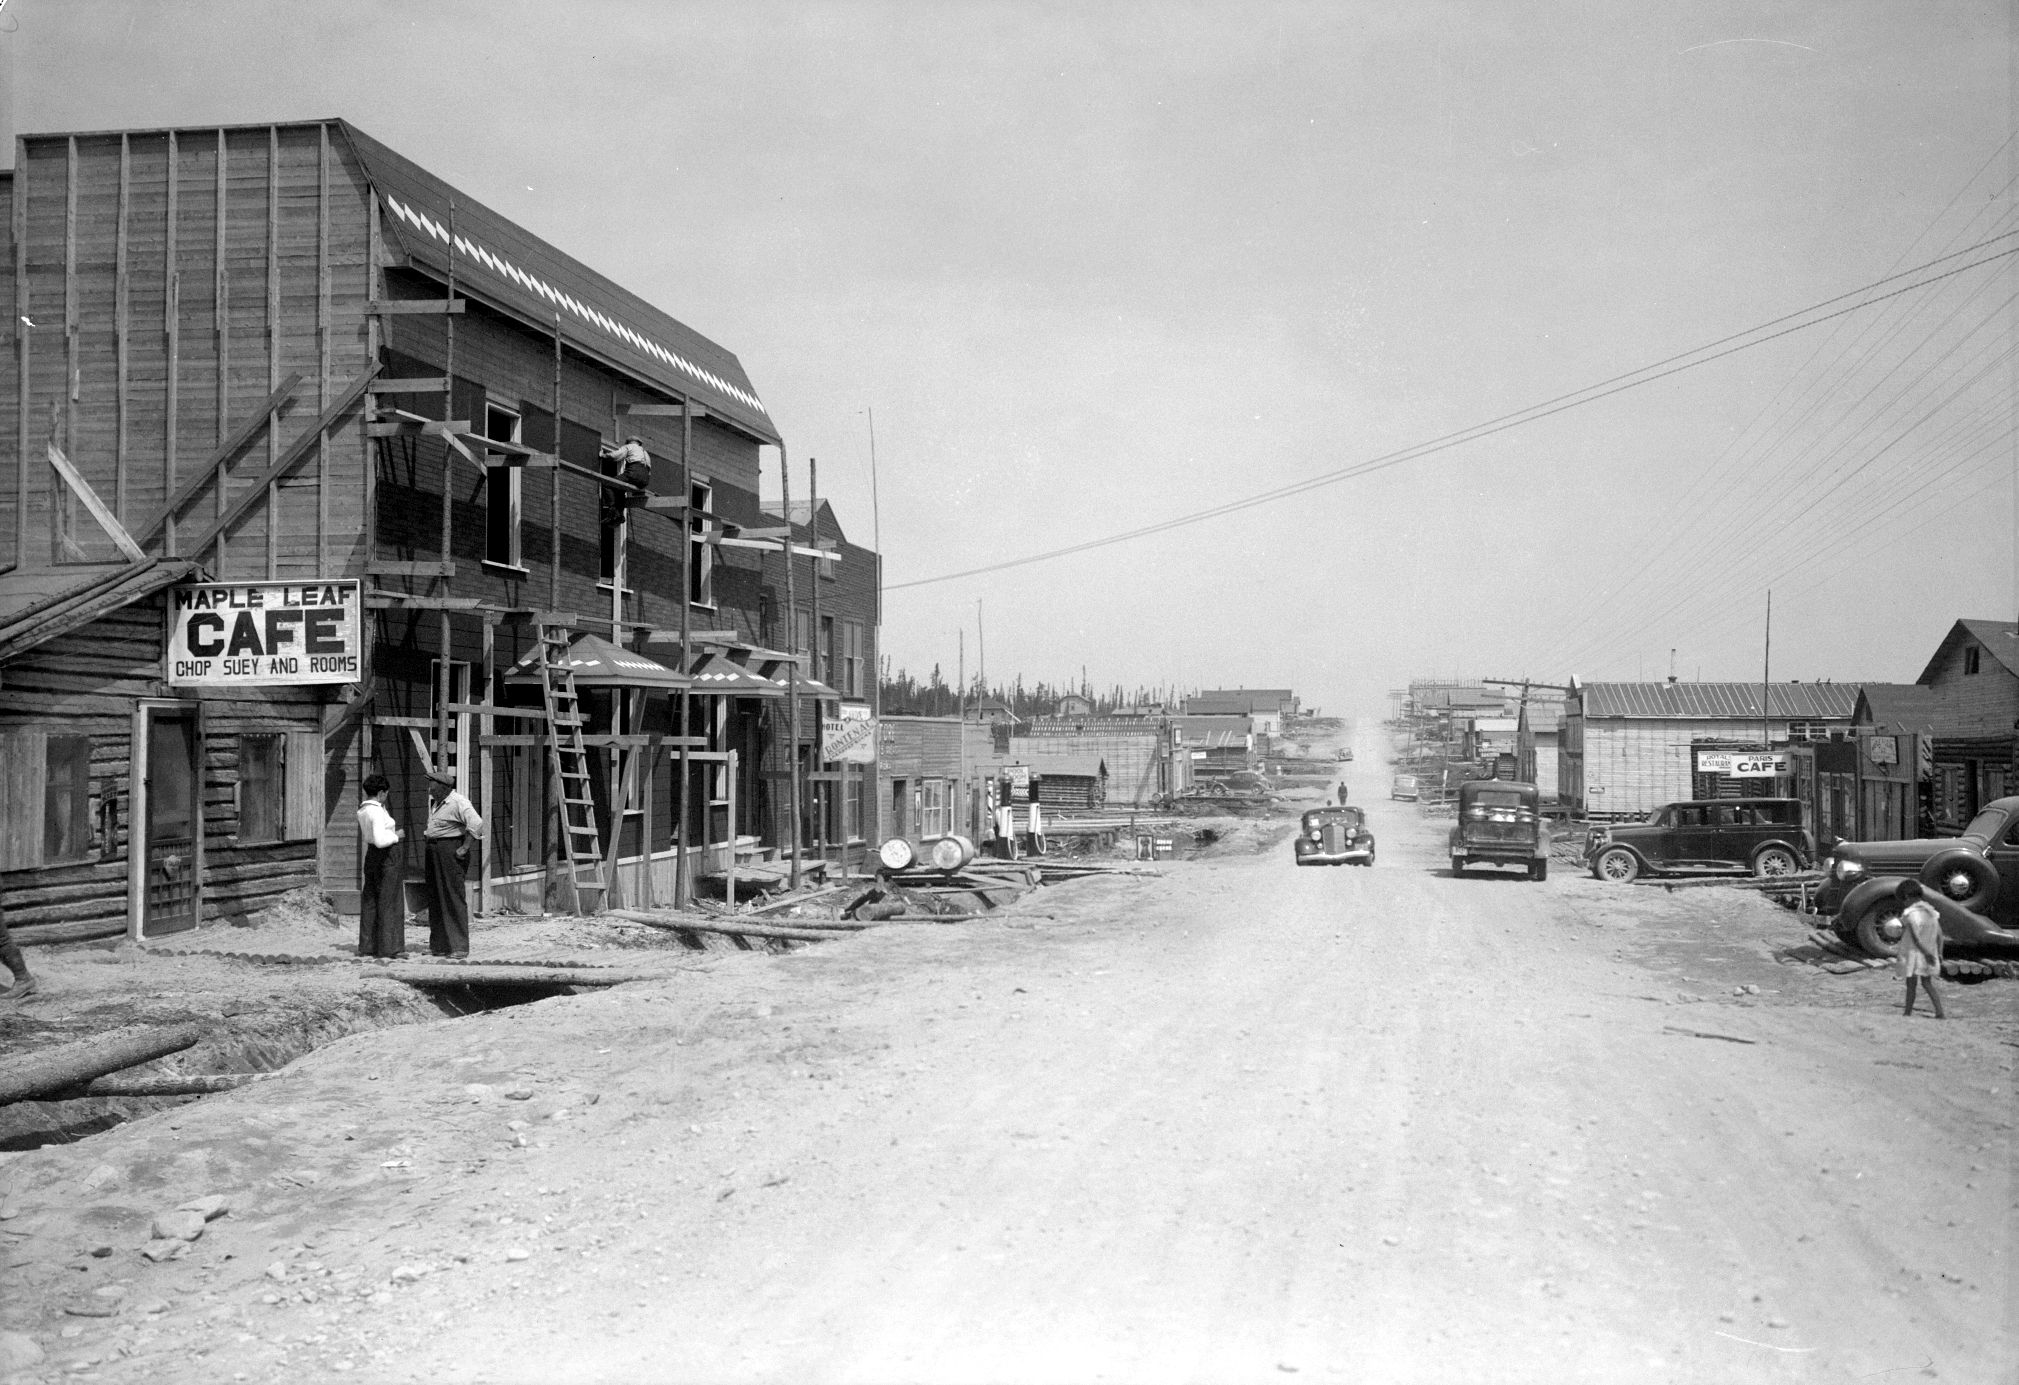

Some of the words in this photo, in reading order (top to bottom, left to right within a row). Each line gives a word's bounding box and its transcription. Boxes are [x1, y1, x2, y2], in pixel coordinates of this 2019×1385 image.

[175, 588, 264, 610] MAPLE
[283, 585, 357, 607] LEAF
[187, 607, 345, 657] CAFE
[175, 660, 212, 677] CHOP
[223, 658, 259, 675] SUEY
[269, 657, 298, 674] AND
[310, 656, 357, 673] ROOMS
[1736, 761, 1787, 772] CAFE
